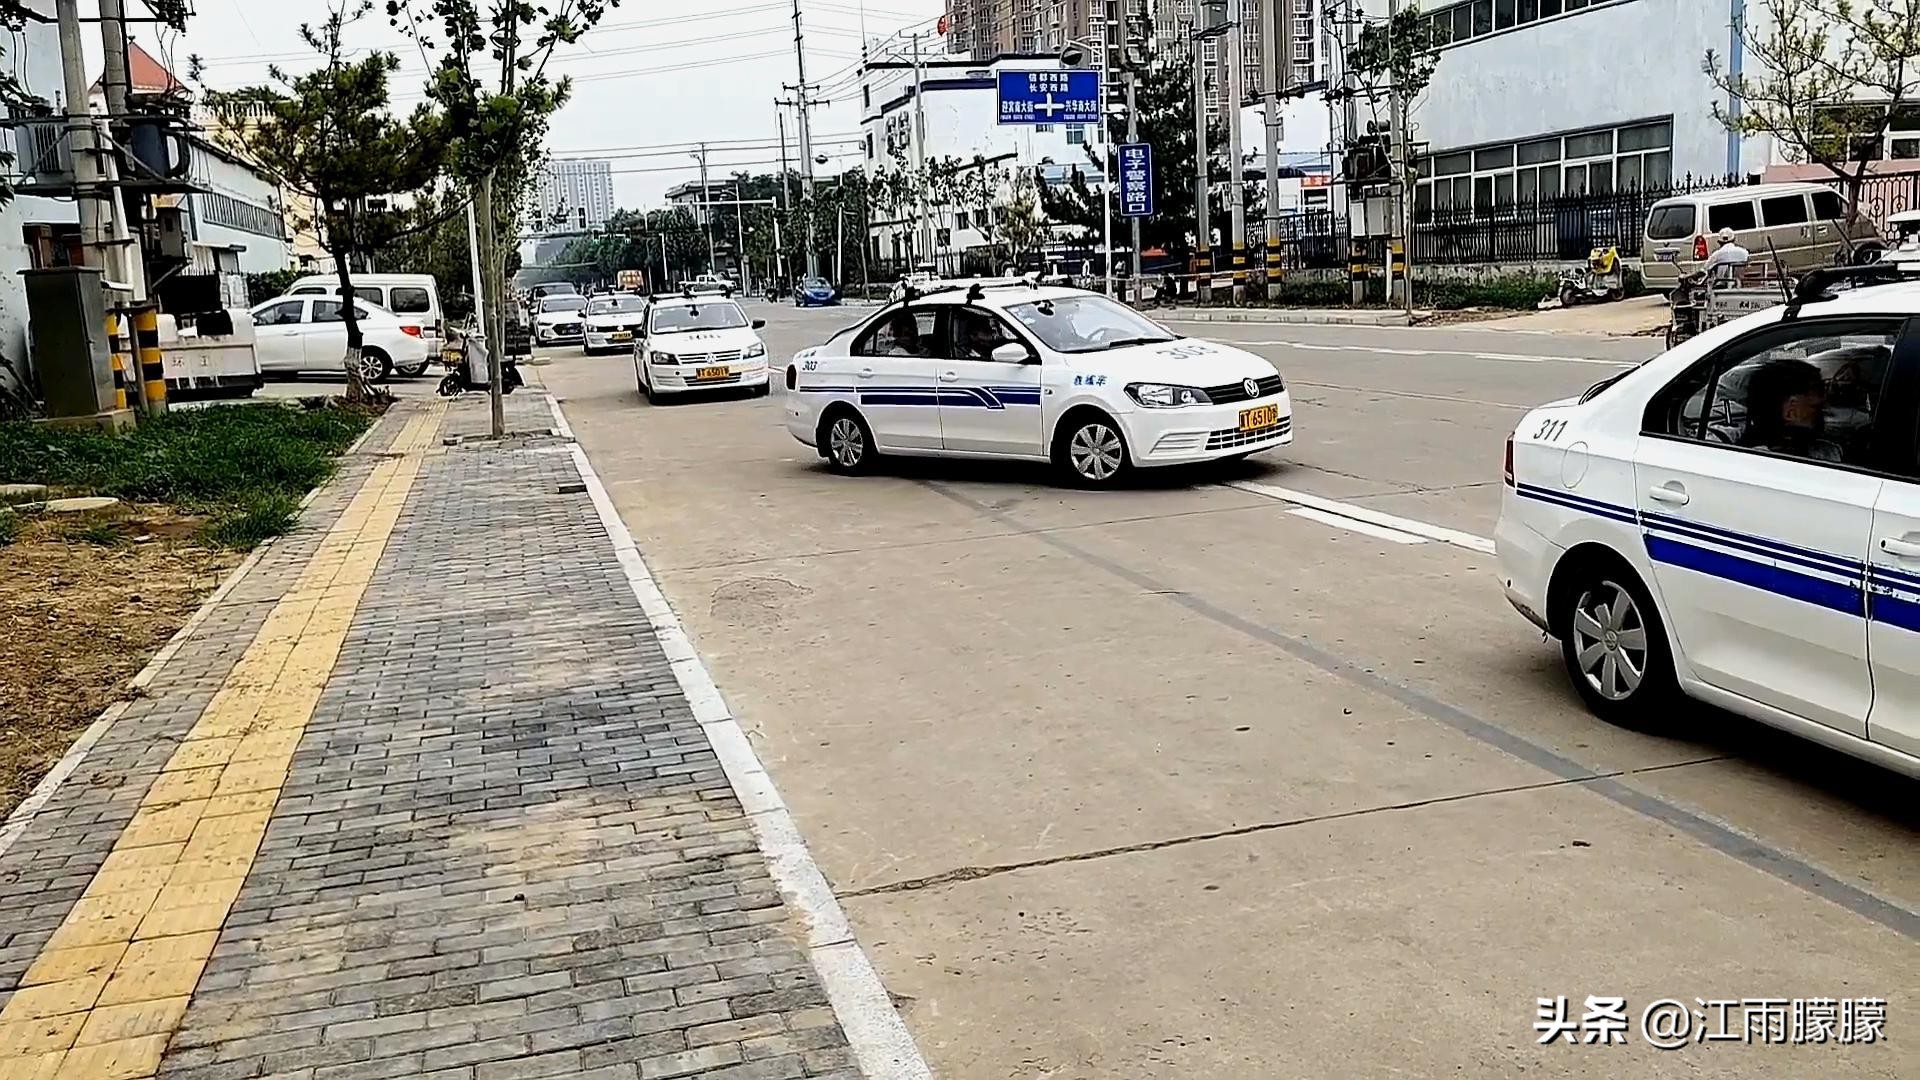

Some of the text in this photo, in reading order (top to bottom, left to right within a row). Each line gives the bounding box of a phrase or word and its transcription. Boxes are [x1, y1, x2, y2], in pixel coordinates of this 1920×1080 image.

[1028, 73, 1069, 82] 信都西路
[1029, 83, 1069, 93] 长安西路
[1065, 100, 1097, 113] 兴华南大街
[1124, 148, 1147, 212] 电子警察路口
[1533, 418, 1569, 442] 311
